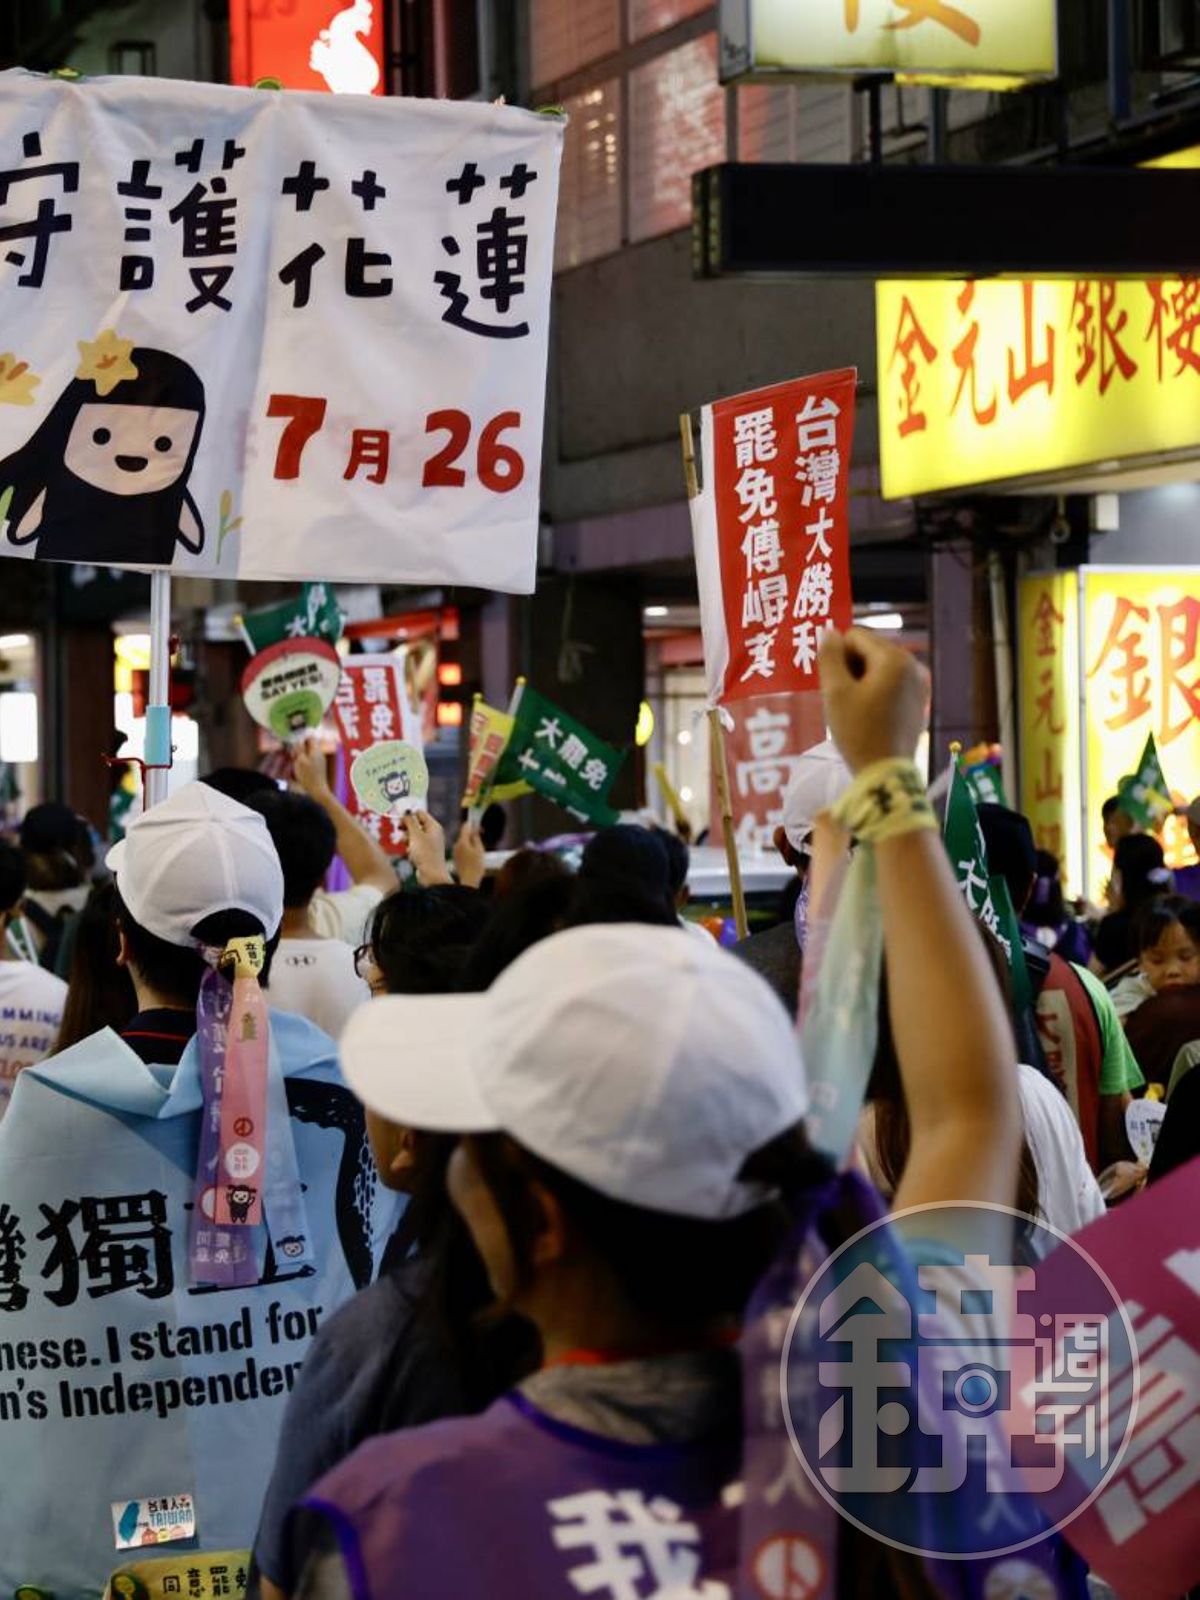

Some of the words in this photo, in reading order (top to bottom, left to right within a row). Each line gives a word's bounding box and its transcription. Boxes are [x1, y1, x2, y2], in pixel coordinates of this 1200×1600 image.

[265, 393, 525, 493] 7月26
[795, 394, 841, 675] 台灣大勝利
[534, 717, 608, 790] 大罷免
[1032, 590, 1065, 850] 金元山
[20, 1036, 50, 1052] ARE
[106, 1326, 120, 1364] I
[131, 1306, 253, 1361] stand
[265, 1301, 323, 1345] for
[162, 1565, 247, 1599] 同意罷免
